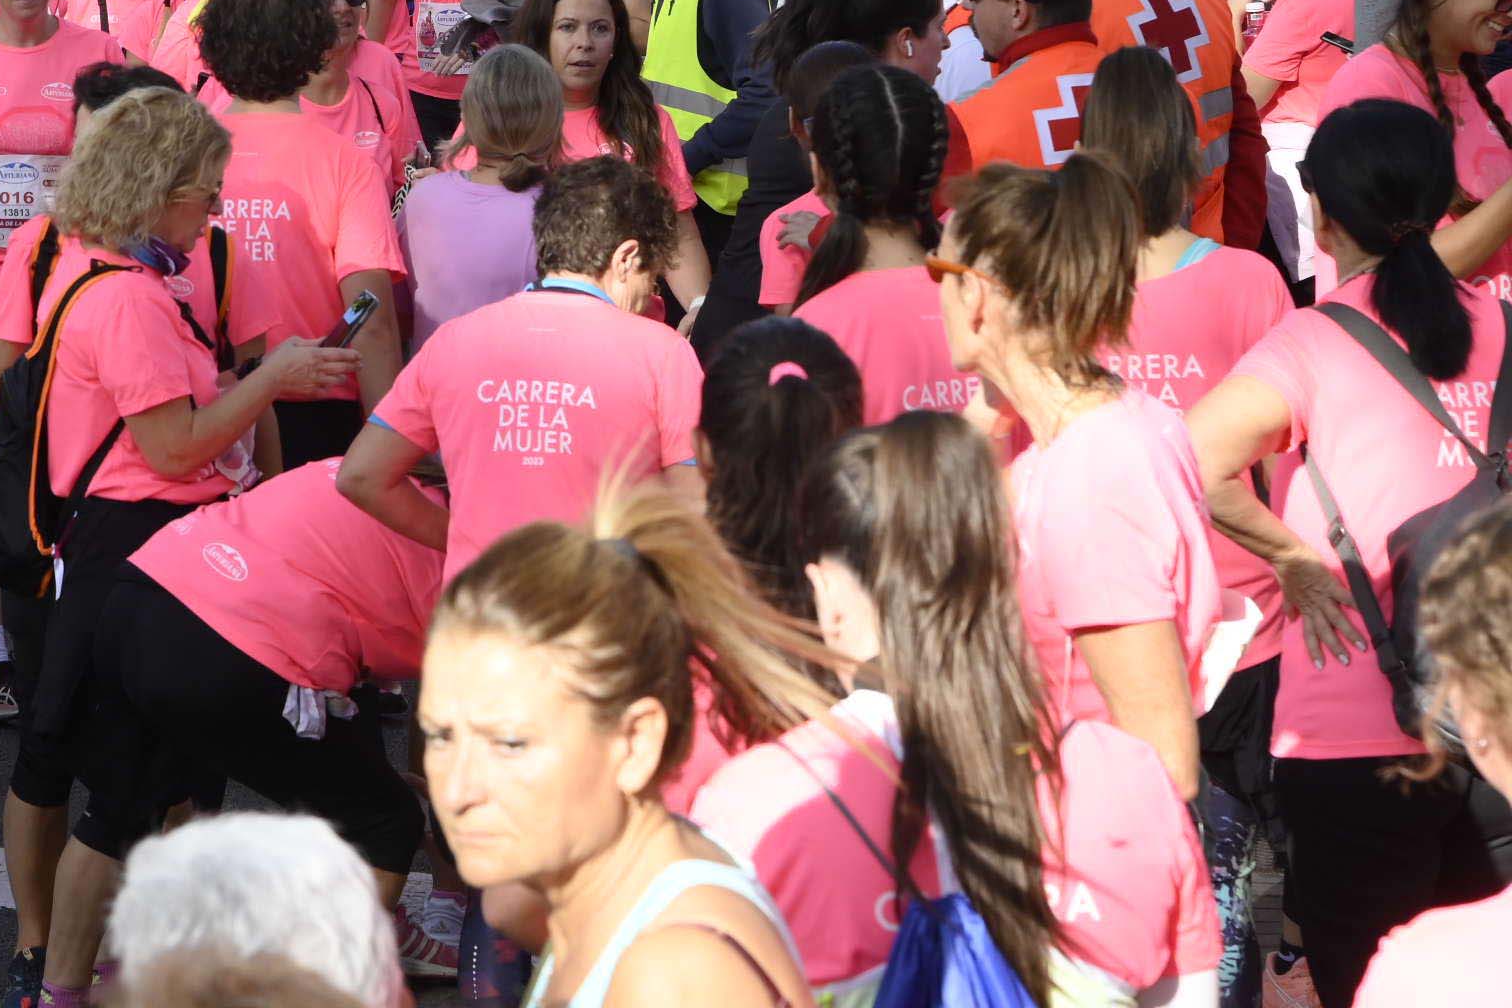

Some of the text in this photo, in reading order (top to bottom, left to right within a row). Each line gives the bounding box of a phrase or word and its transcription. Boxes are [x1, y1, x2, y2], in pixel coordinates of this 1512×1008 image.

[0, 191, 34, 204] 016
[3, 208, 30, 217] 13813
[246, 220, 271, 240] LA
[477, 379, 597, 410] CARRERA
[498, 404, 569, 430] DE LA
[492, 428, 572, 455] MUJER
[521, 456, 544, 466] 2023
